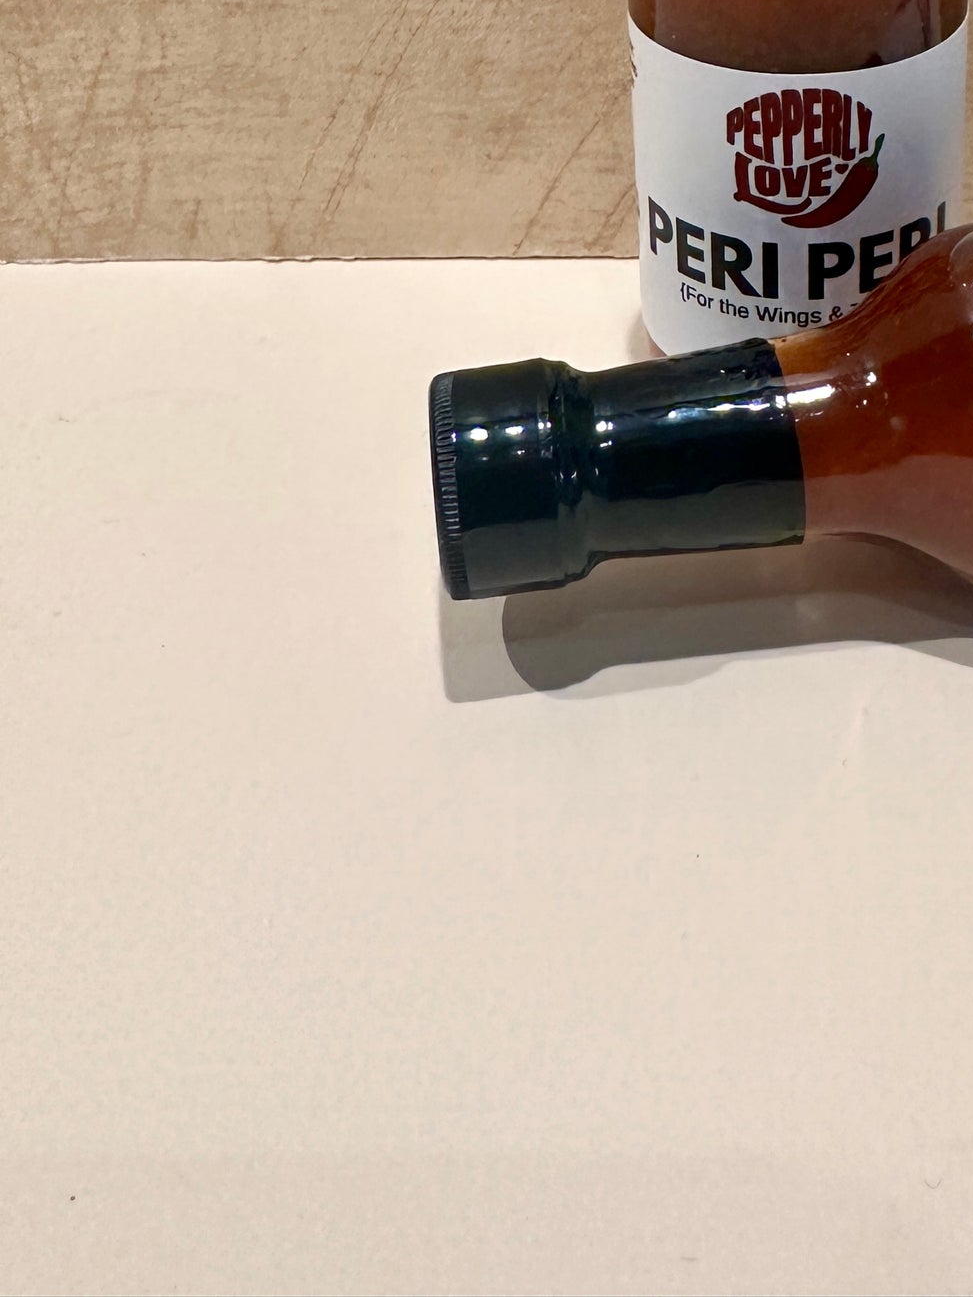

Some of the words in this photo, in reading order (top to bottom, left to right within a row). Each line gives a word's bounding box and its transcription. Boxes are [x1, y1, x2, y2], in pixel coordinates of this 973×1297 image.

[726, 88, 872, 166] PEPPERLY
[733, 151, 832, 215] LOVE
[648, 196, 779, 299] PERI
[719, 299, 749, 319] the
[755, 305, 822, 328] Wings
[828, 306, 843, 321] &
